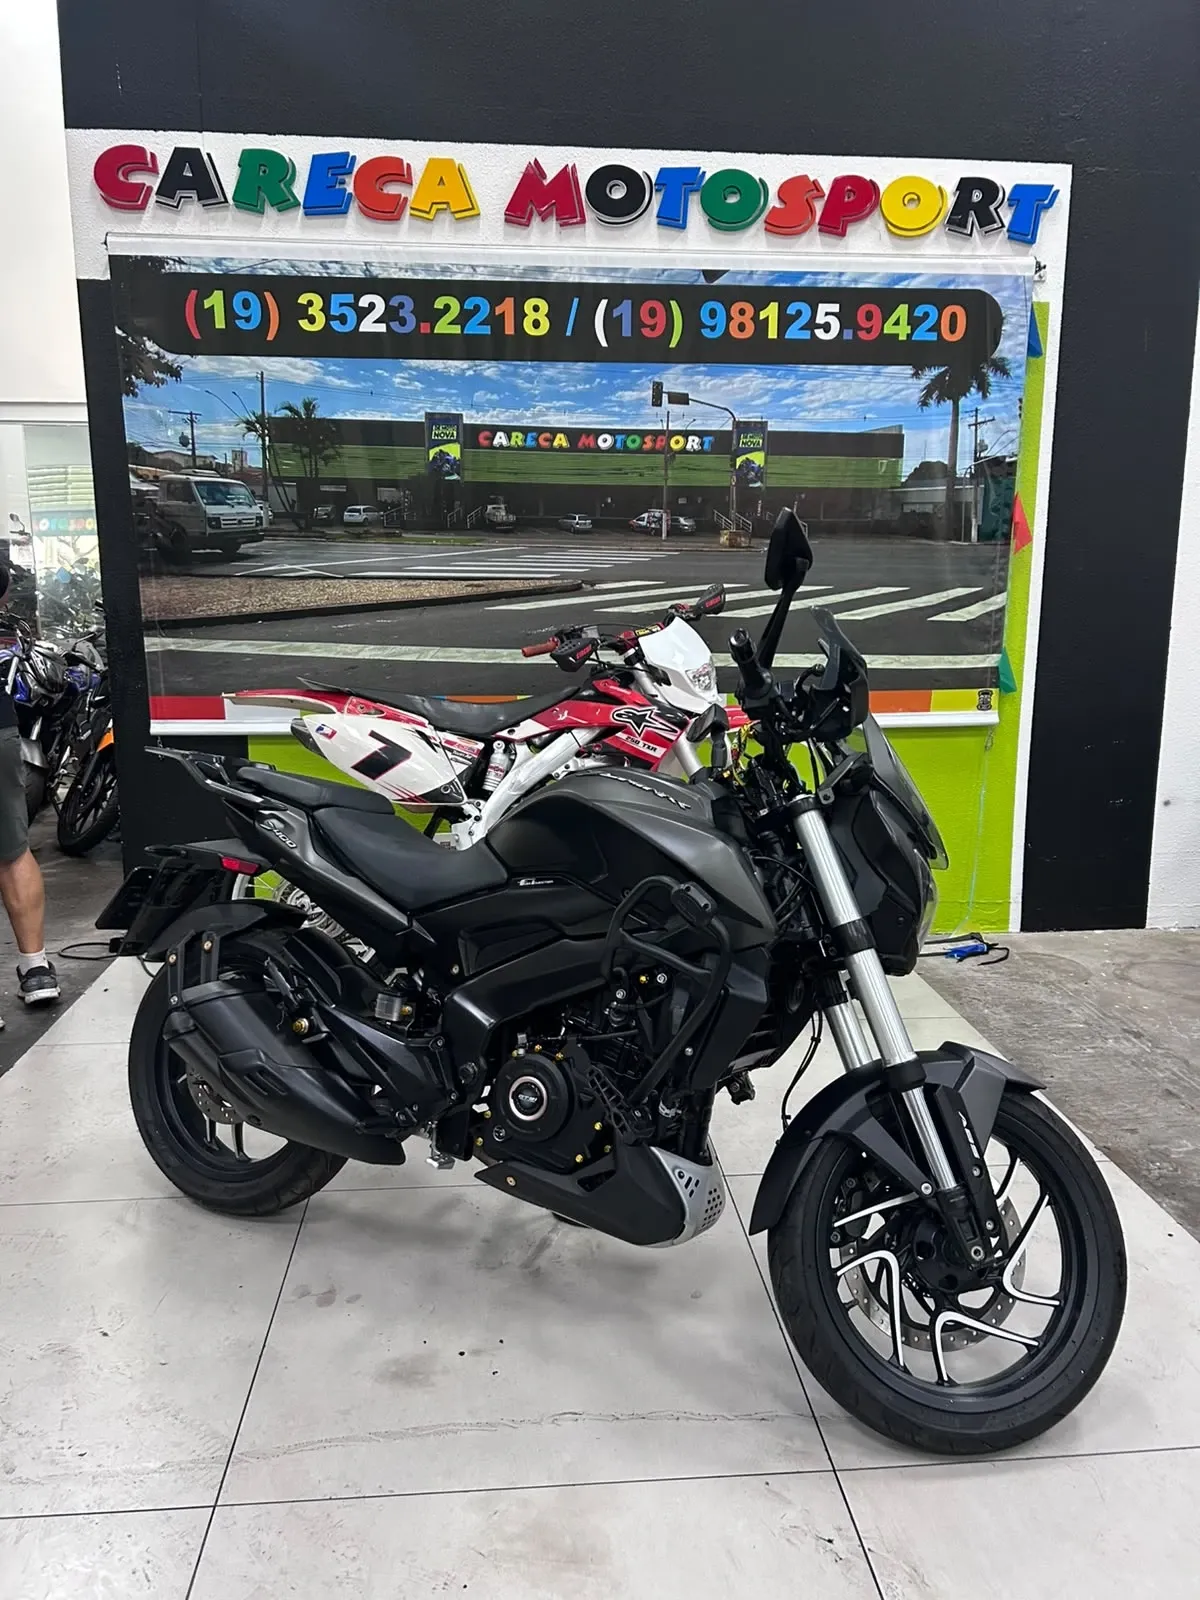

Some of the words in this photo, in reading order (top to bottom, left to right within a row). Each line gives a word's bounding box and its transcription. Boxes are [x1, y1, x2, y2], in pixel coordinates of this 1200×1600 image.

[93, 144, 481, 221] CARECA
[504, 157, 1060, 245] MOTOSPORT
[185, 289, 281, 341] (19)
[297, 292, 550, 336] 3523.2218
[594, 298, 683, 348] (19)
[700, 301, 967, 342] 98125.9420
[478, 431, 570, 448] CARECA
[578, 433, 715, 452] MOTOSPORT
